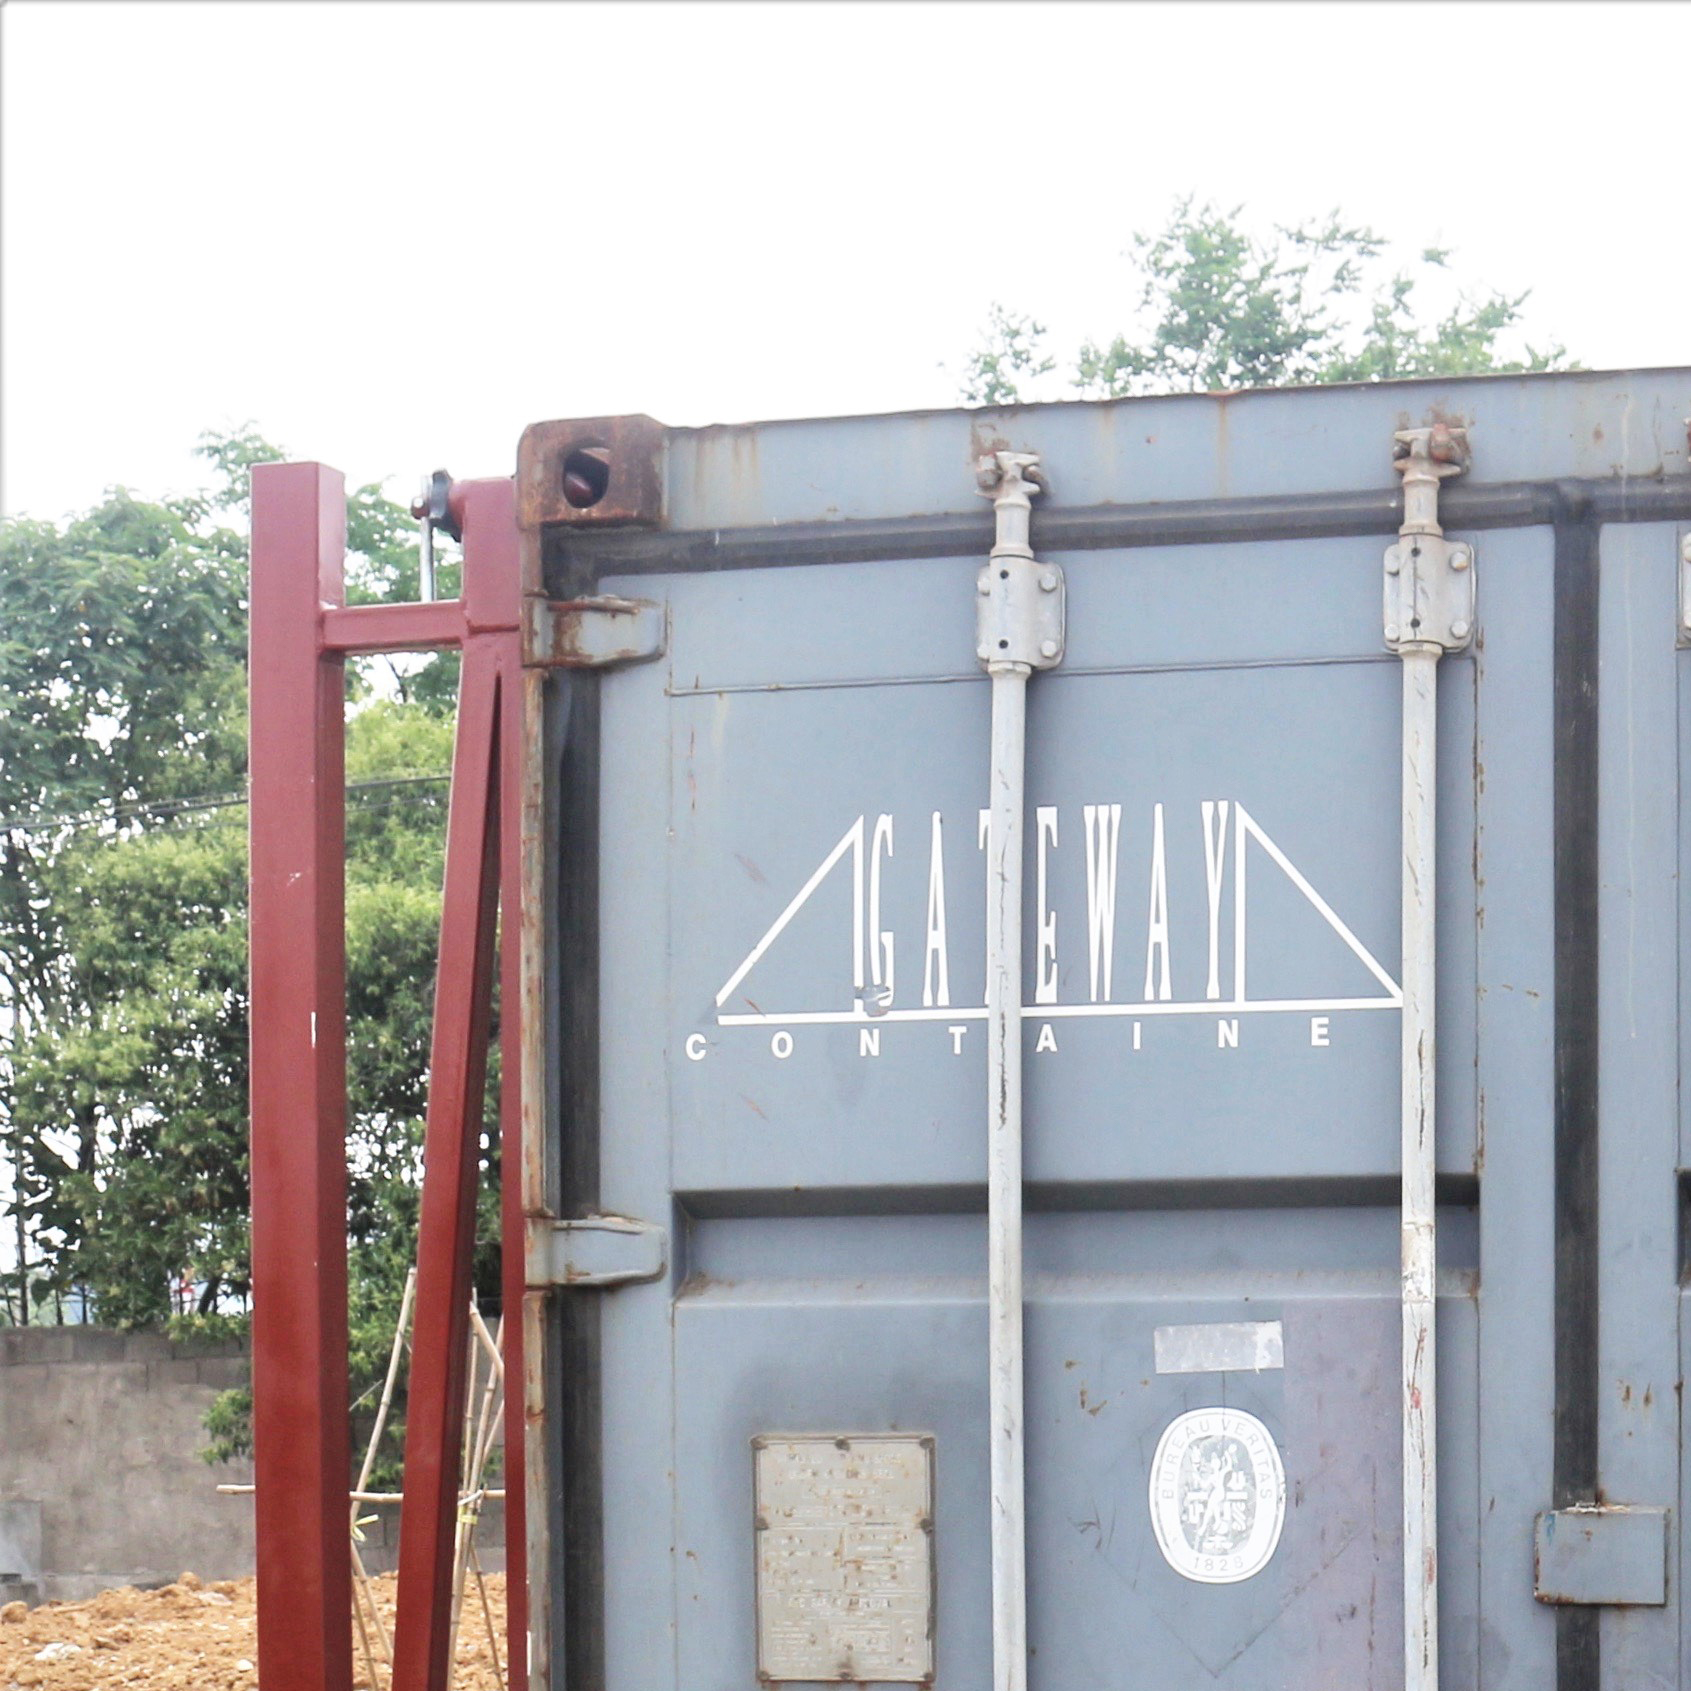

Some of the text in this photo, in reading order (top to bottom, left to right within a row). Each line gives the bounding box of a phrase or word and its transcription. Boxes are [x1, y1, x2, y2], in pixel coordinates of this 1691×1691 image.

[1162, 1418, 1273, 1500] BUREAU VERITAS
[1193, 1555, 1245, 1573] 1828
